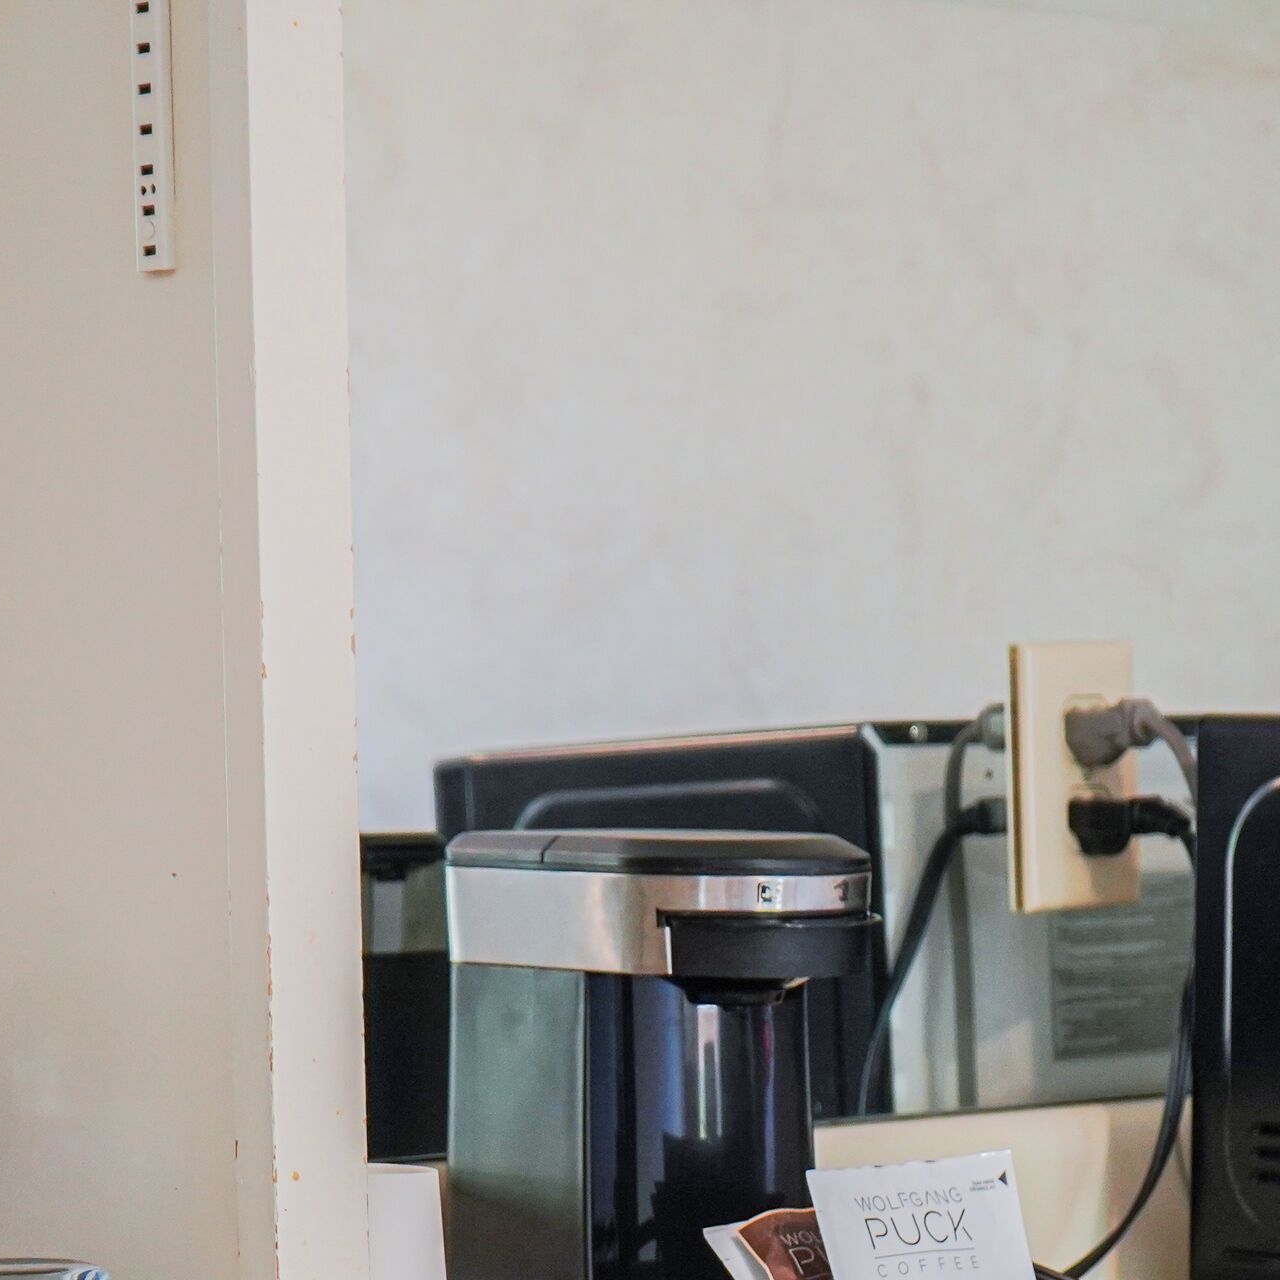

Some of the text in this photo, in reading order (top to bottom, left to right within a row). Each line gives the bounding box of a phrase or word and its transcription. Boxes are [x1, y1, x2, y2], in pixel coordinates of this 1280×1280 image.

[854, 1186, 963, 1212] WOLFGANG
[864, 1208, 973, 1250] PUCK
[877, 1255, 981, 1279] COFFEE
